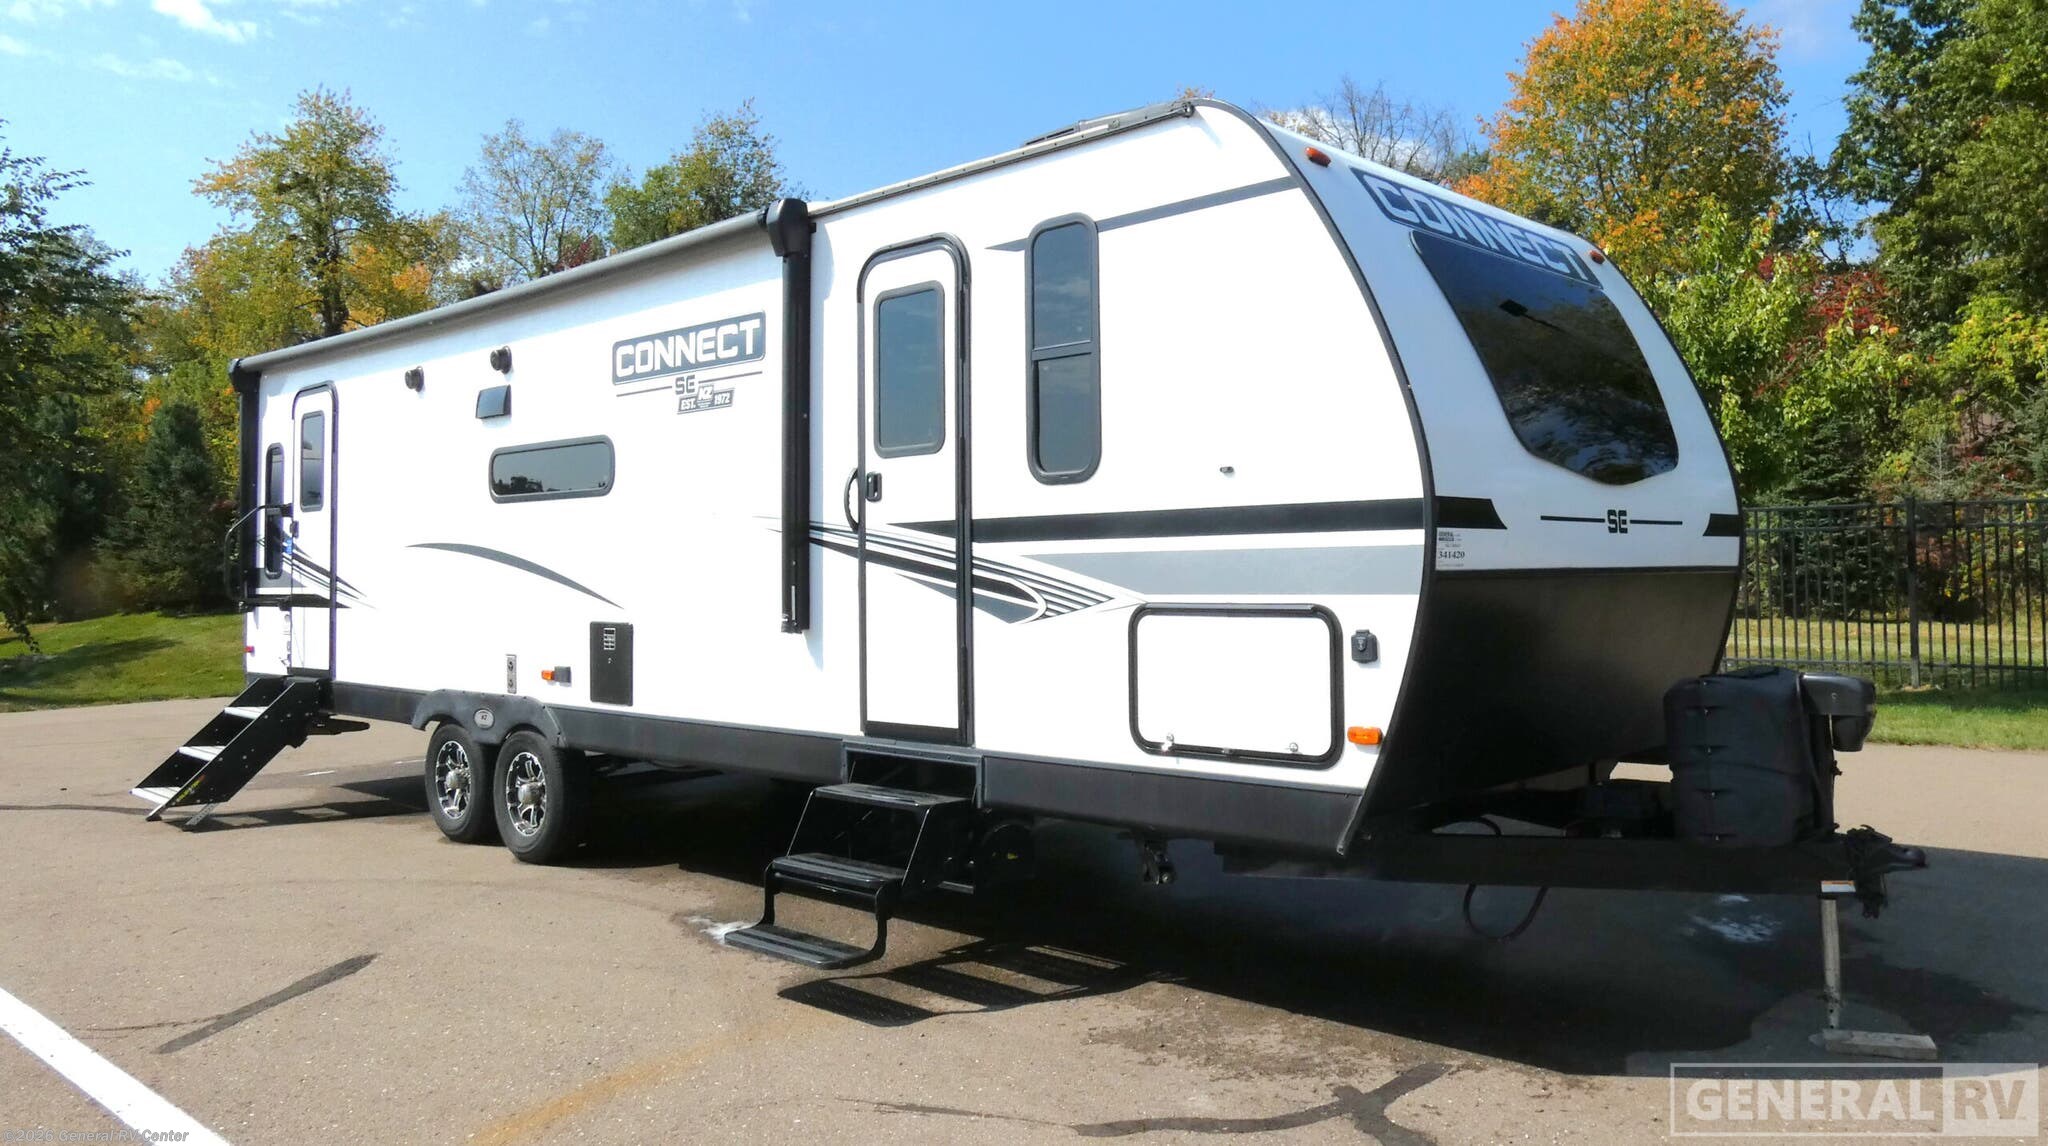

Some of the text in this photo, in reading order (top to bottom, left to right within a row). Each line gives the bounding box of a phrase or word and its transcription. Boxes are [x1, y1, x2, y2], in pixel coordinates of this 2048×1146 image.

[1366, 174, 1589, 281] CONNECT
[616, 319, 761, 378] CONNECT
[675, 374, 696, 395] SE
[714, 392, 731, 406] 1972
[1607, 509, 1628, 534] SE
